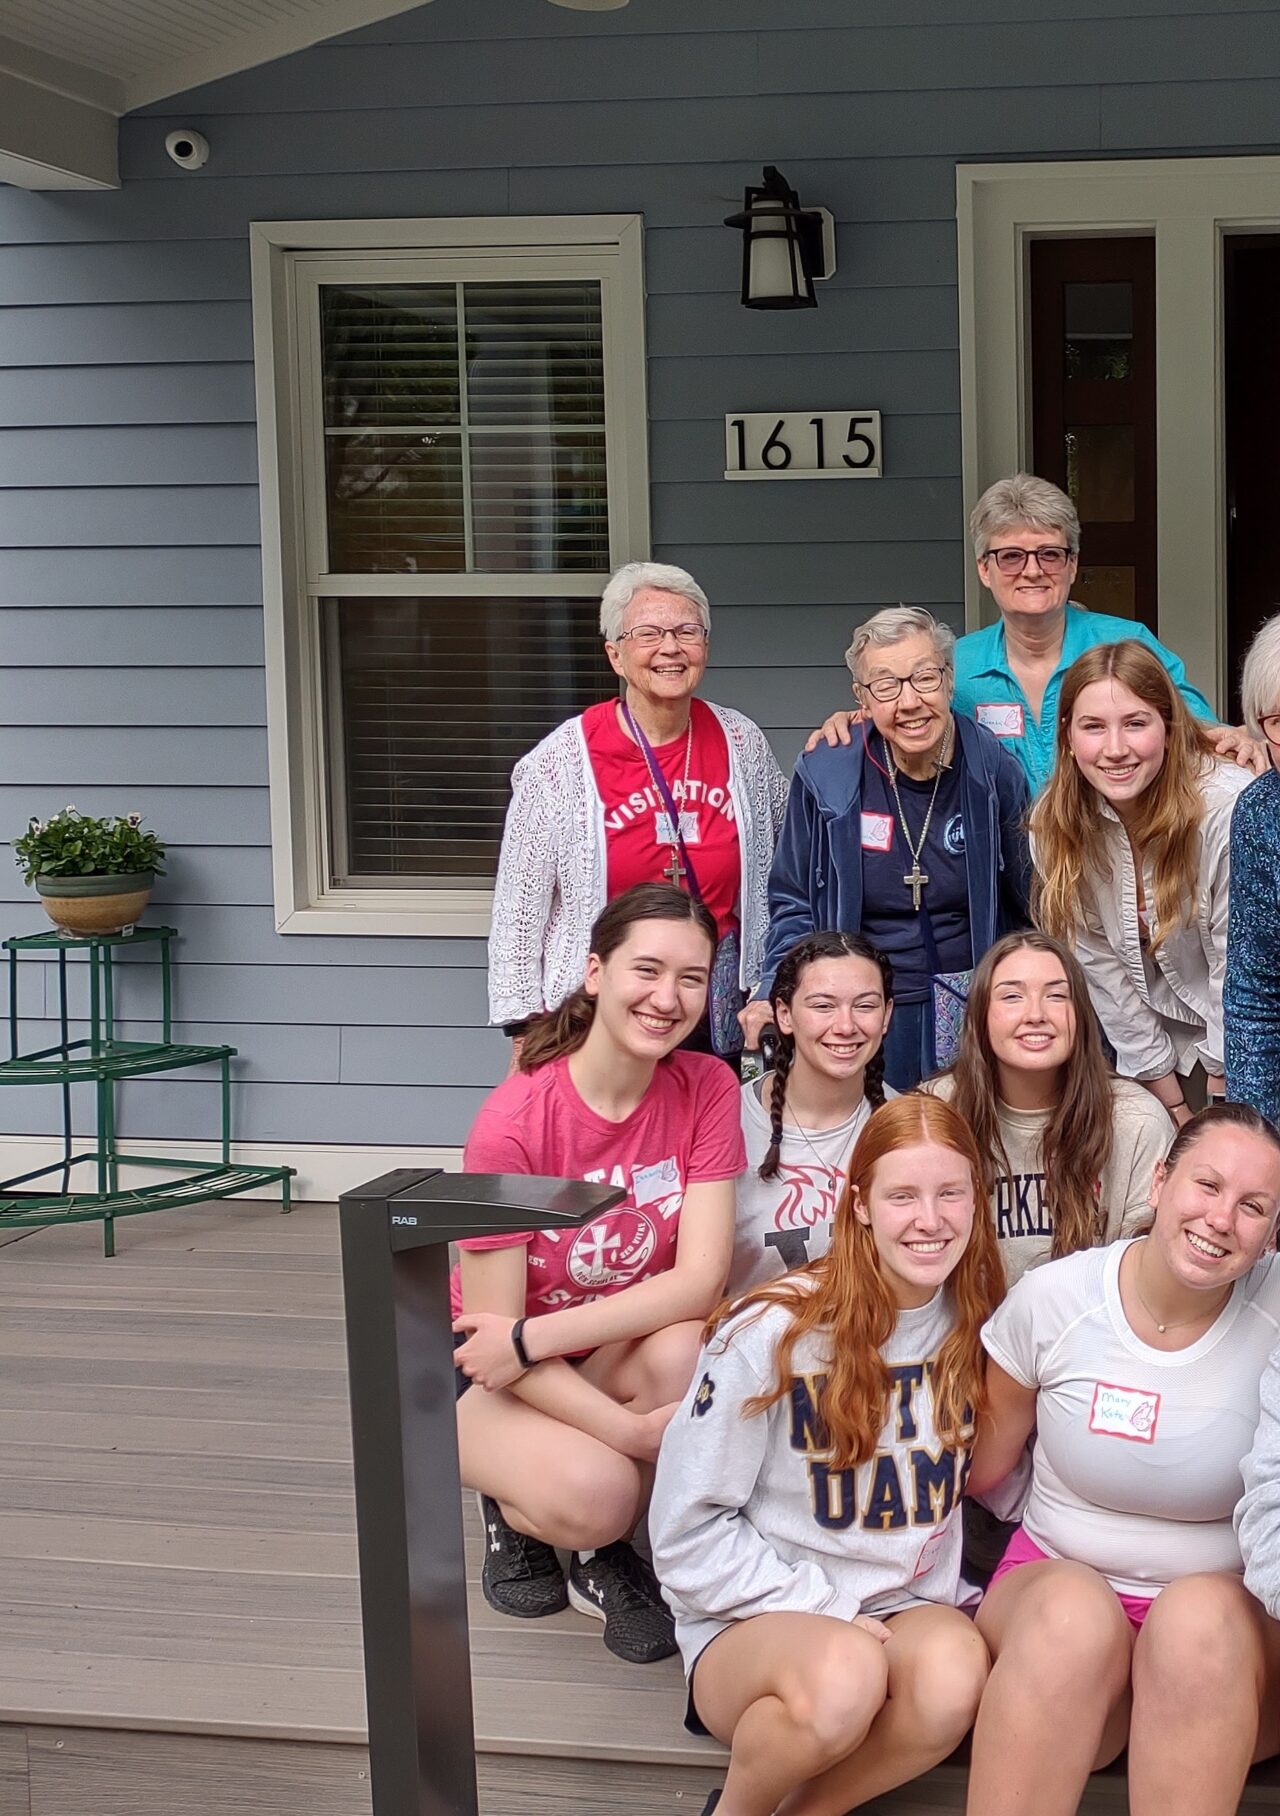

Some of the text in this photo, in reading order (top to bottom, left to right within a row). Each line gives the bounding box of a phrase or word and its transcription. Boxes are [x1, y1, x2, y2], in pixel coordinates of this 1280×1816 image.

[731, 417, 875, 470] 1615
[605, 779, 736, 829] VISIATION
[392, 1216, 417, 1225] RAB
